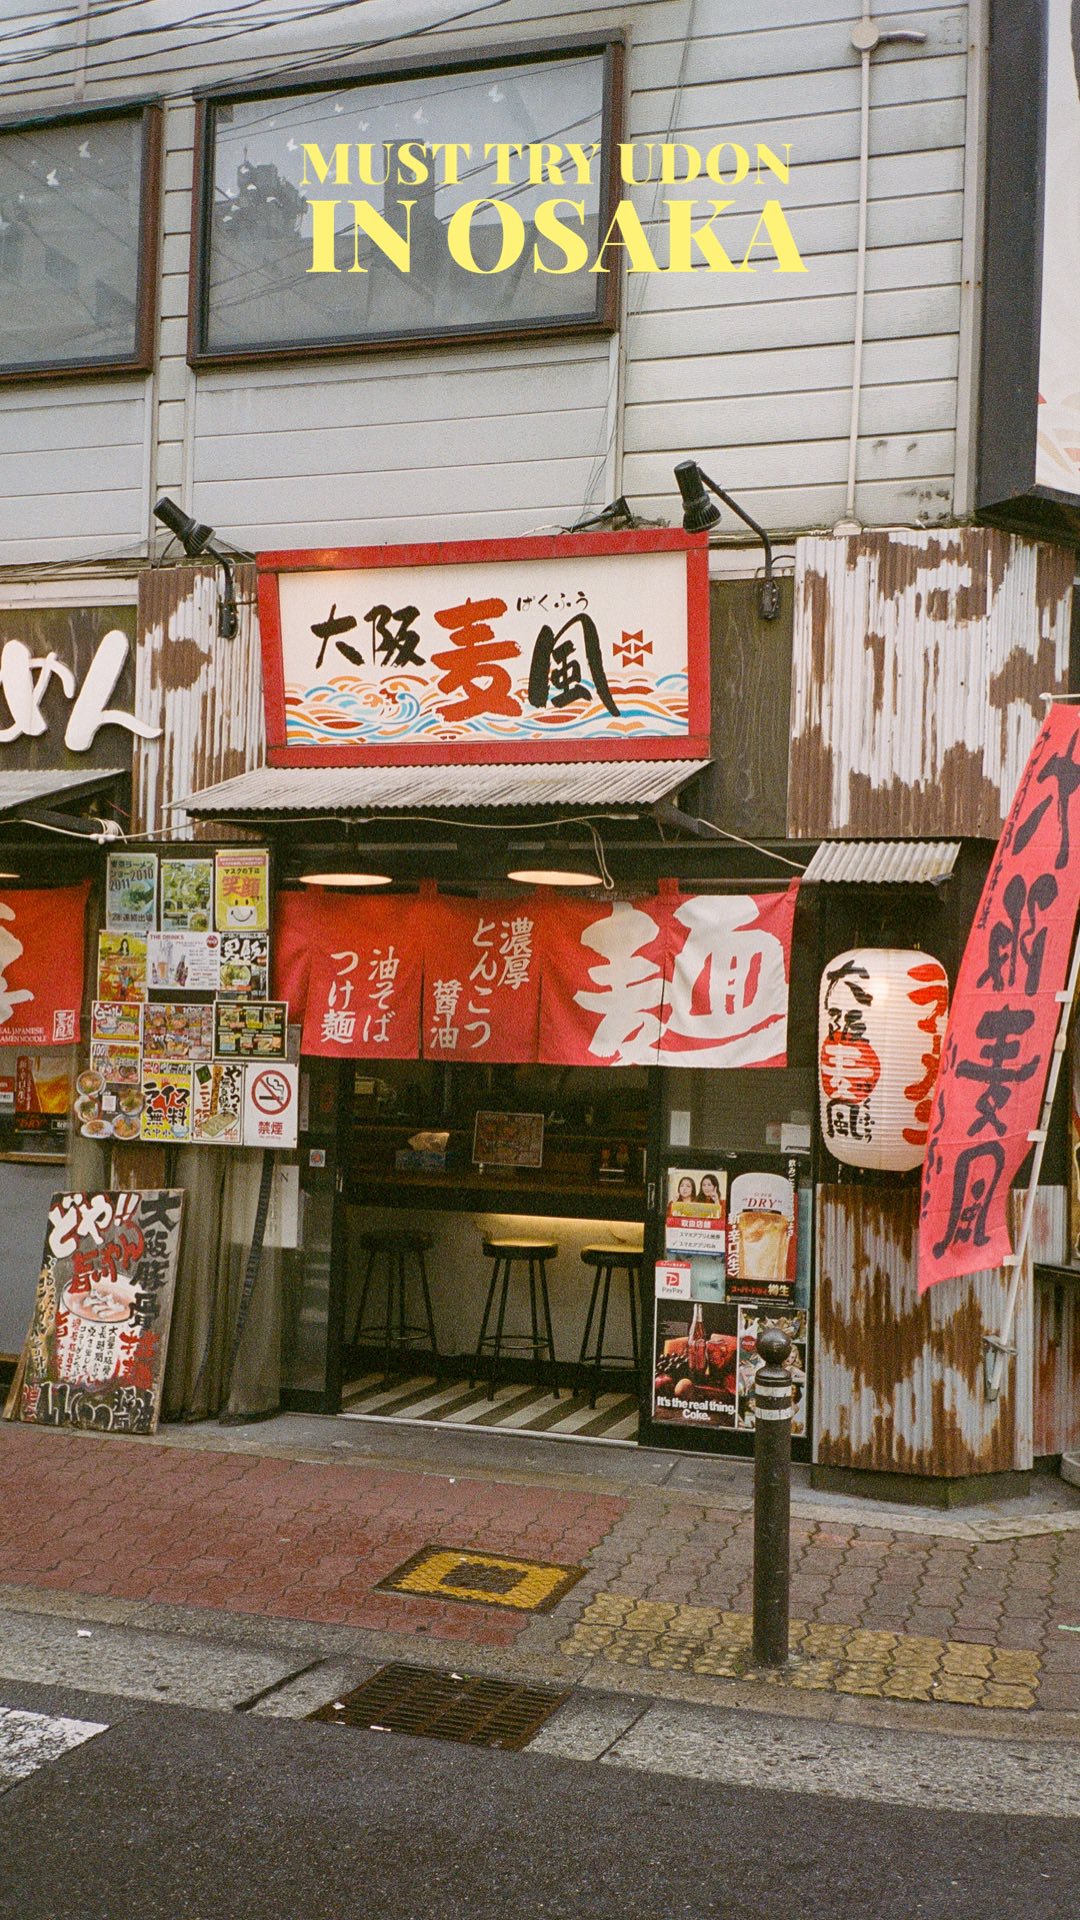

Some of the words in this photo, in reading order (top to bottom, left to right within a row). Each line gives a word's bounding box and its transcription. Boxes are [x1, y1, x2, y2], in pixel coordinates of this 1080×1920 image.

[516, 591, 589, 613] ばくふう
[310, 597, 621, 723] 大阪麦風
[223, 876, 261, 898] 笑顔
[498, 917, 534, 989] 濃厚
[362, 945, 400, 1043] 油そば
[468, 918, 500, 1049] とんこつ
[320, 950, 358, 1044] つけ麺
[430, 979, 464, 1050] 醤油
[143, 1081, 191, 1105] ライス
[146, 1106, 188, 1126] 無料
[257, 1121, 283, 1136] 禁煙
[661, 1286, 683, 1294] PayPay
[657, 1396, 671, 1407] It's
[672, 1398, 688, 1409] the
[689, 1399, 708, 1410] real
[709, 1400, 737, 1414] thing.
[682, 1409, 711, 1421] Coke.
